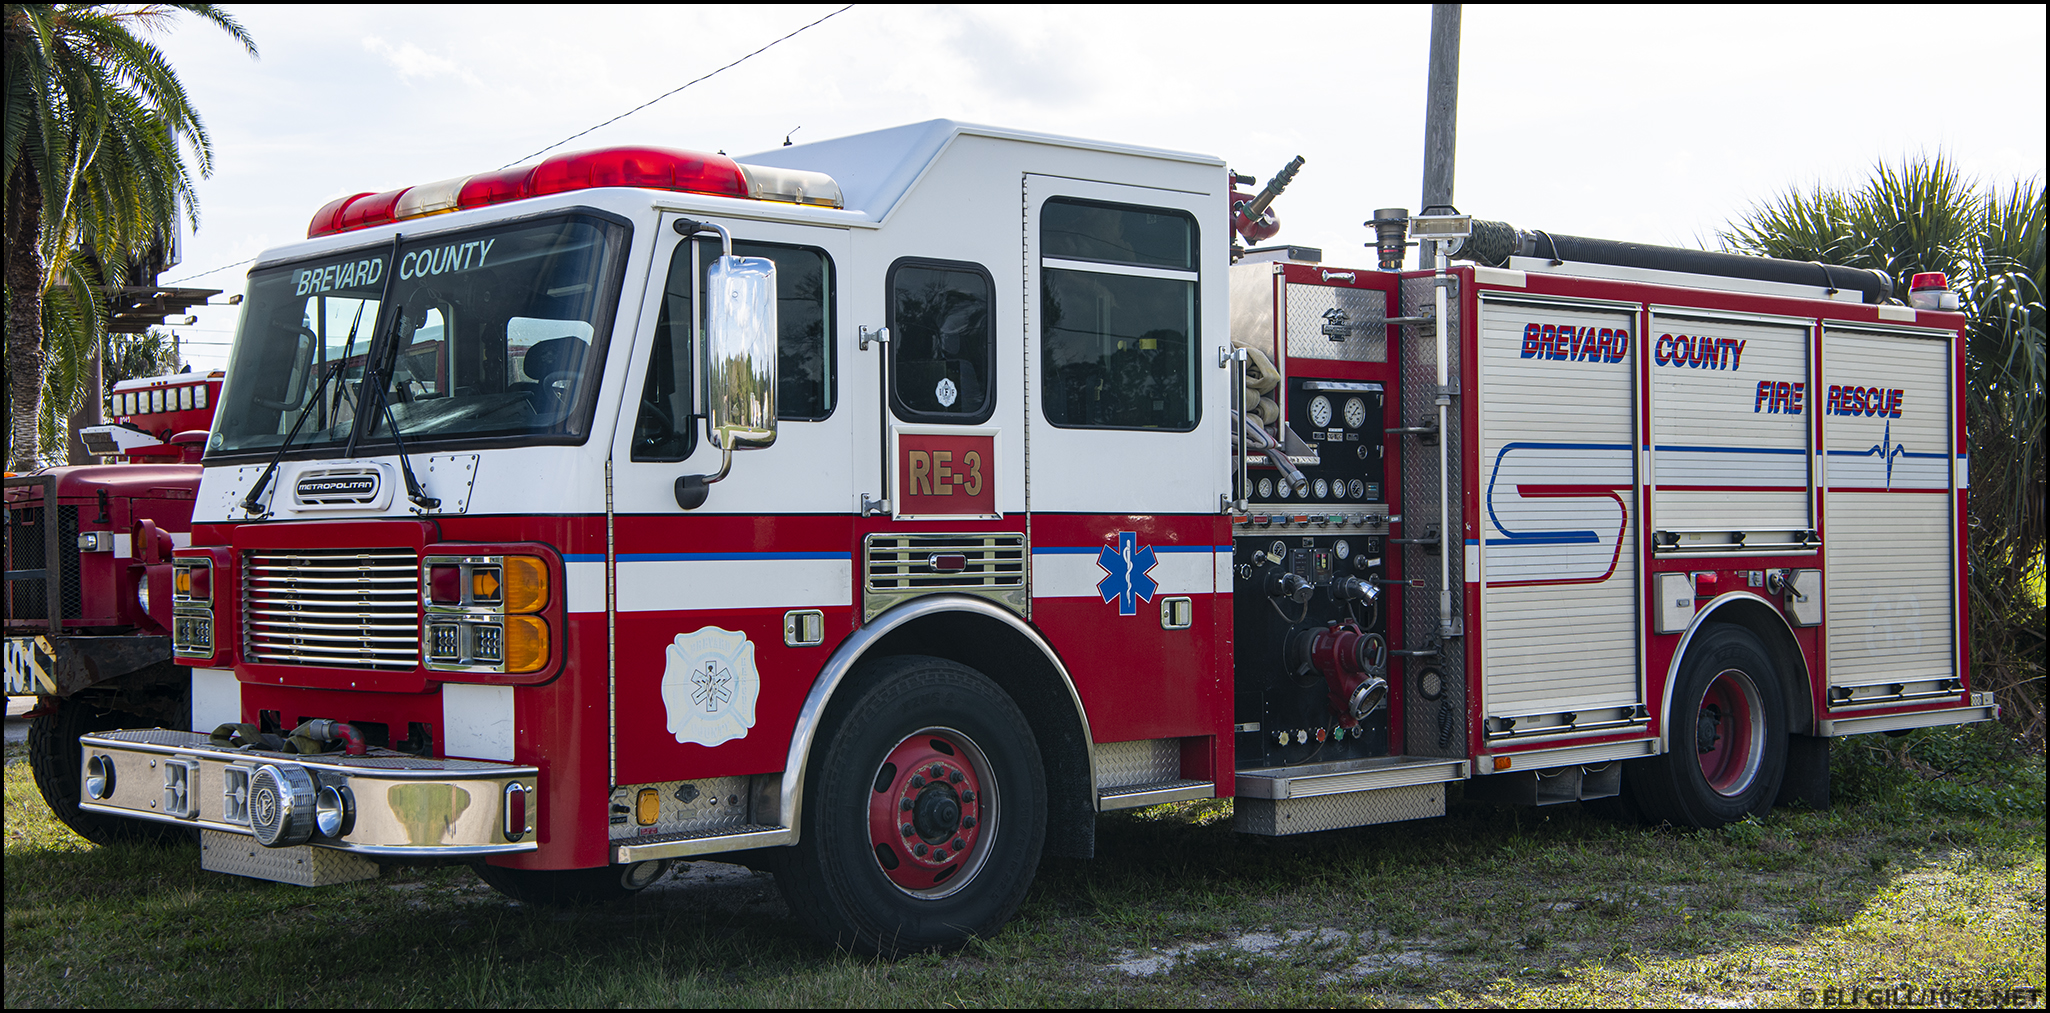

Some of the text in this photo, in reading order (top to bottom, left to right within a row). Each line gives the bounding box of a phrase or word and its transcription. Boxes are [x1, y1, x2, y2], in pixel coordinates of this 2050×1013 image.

[296, 238, 495, 297] BREVARD COUNTY
[1520, 322, 1747, 371] BREVARD COUNTY
[1754, 380, 1904, 419] FIRE RESCUE
[298, 481, 373, 491] METROPOLITAN
[908, 450, 983, 497] RE-3
